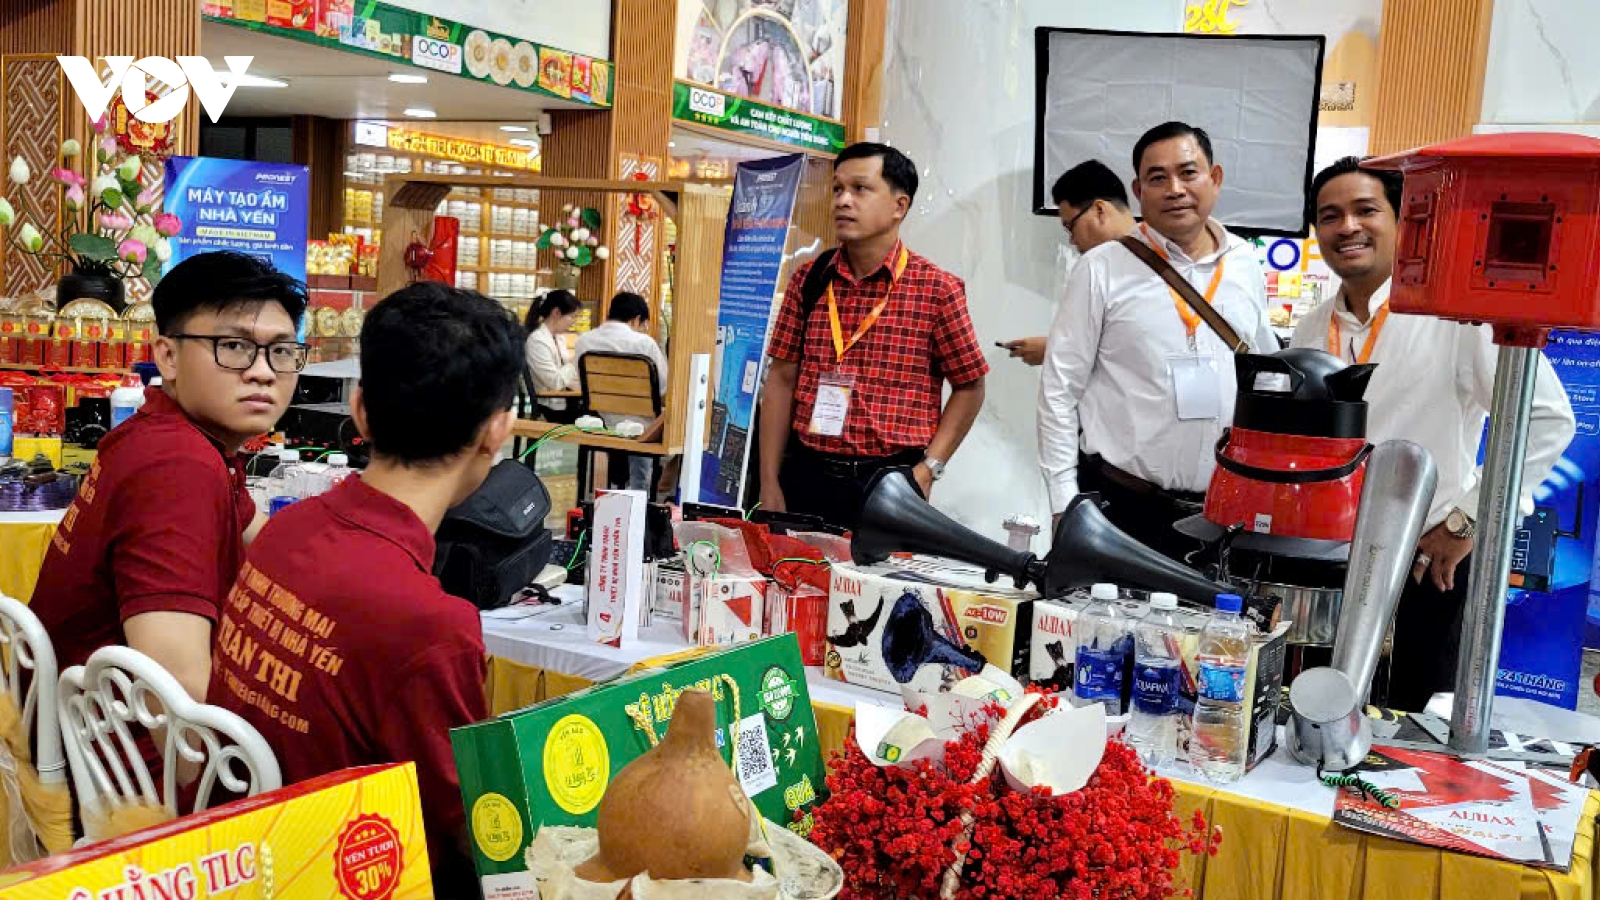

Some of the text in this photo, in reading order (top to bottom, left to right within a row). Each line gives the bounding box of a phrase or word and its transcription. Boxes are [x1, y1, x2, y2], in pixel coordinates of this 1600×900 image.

[418, 38, 458, 60] OCOP
[692, 91, 723, 108] OCOP
[188, 187, 225, 204] MÁY
[228, 191, 258, 209] TẠO
[200, 207, 275, 225] NHÀ YẾN
[600, 612, 611, 624] 4
[202, 845, 255, 893] TLC
[355, 860, 392, 895] 30%
